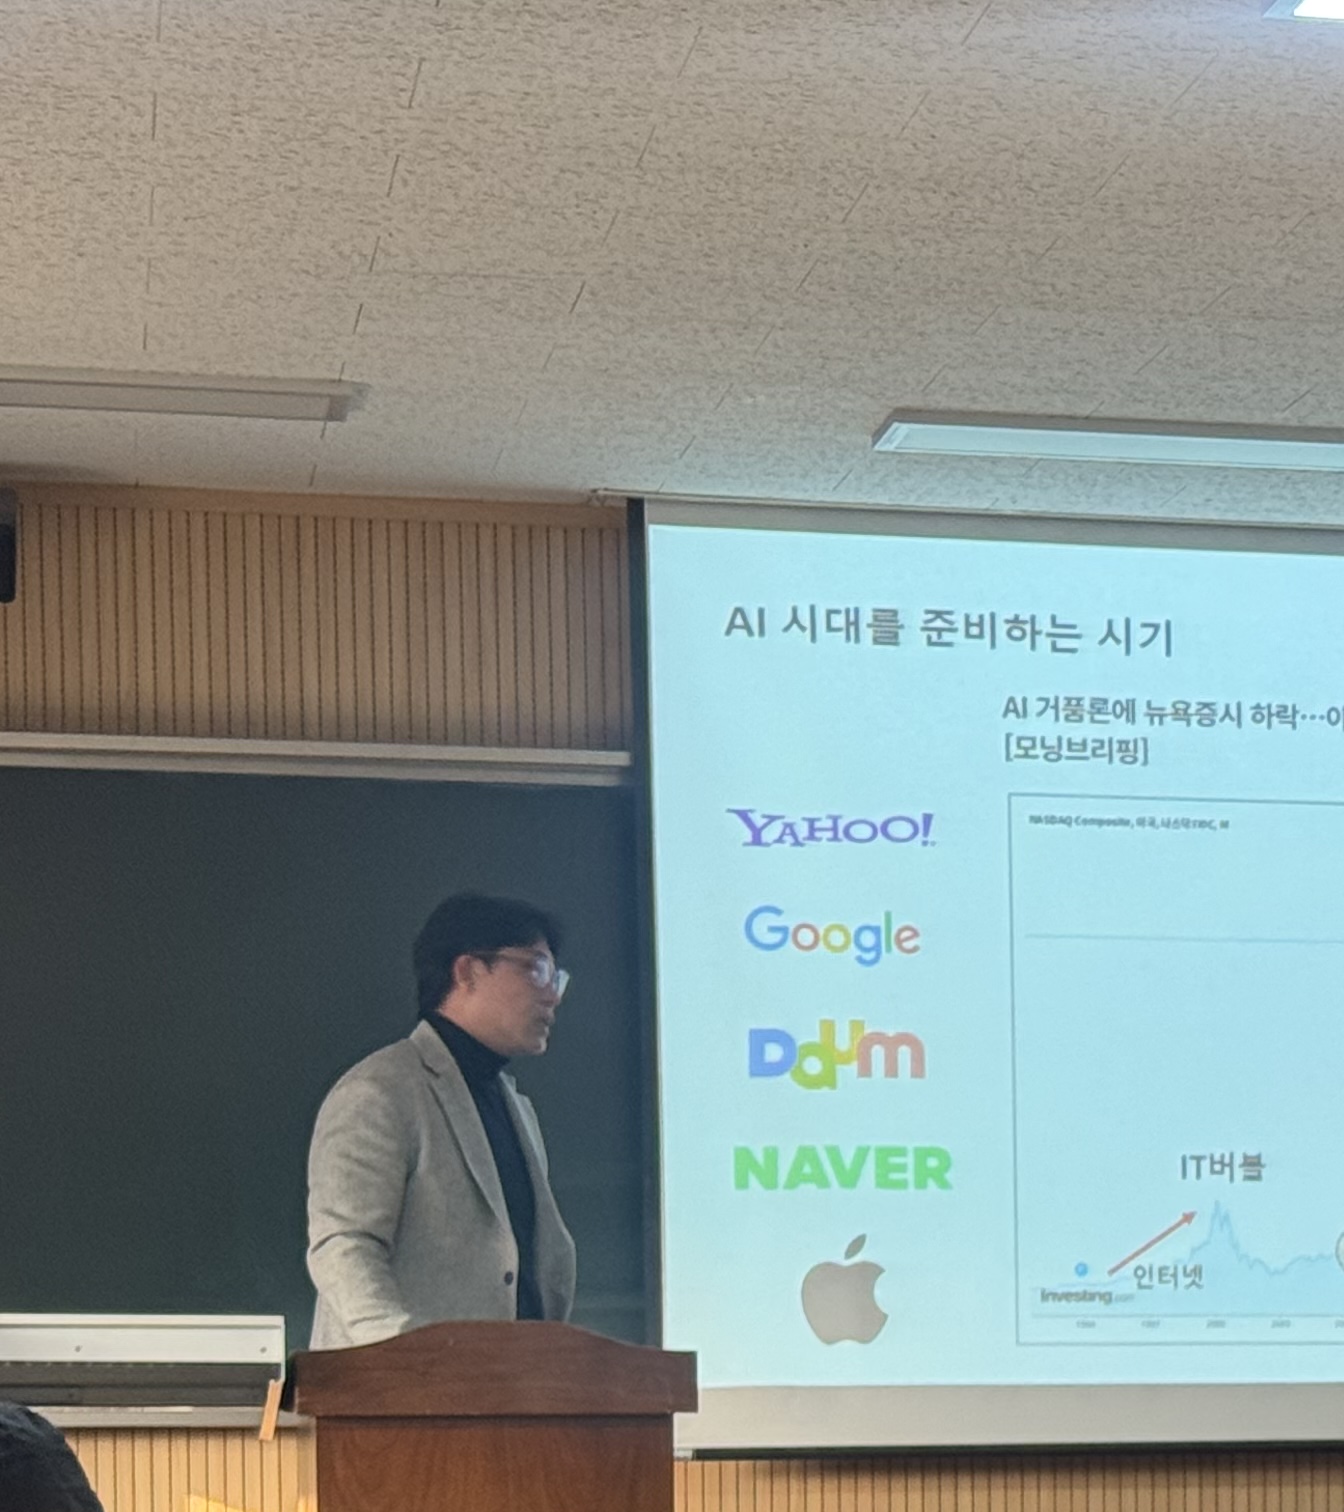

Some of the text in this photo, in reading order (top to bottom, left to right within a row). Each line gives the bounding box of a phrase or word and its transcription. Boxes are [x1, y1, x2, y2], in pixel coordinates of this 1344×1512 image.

[724, 603, 1173, 658] AI 시대를 준비하는 시기
[1002, 695, 1028, 720] AI
[1035, 695, 1137, 726] 거품론에
[1143, 699, 1243, 730] 뉴욕증시
[1004, 732, 1149, 767] [모닝브리핑]
[725, 808, 936, 848] YAHOO!
[744, 905, 921, 968] Google
[748, 1018, 926, 1091] Daum
[733, 1145, 954, 1191] NAVER
[1181, 1151, 1267, 1184] IT버블
[1133, 1264, 1204, 1290] 인터넷
